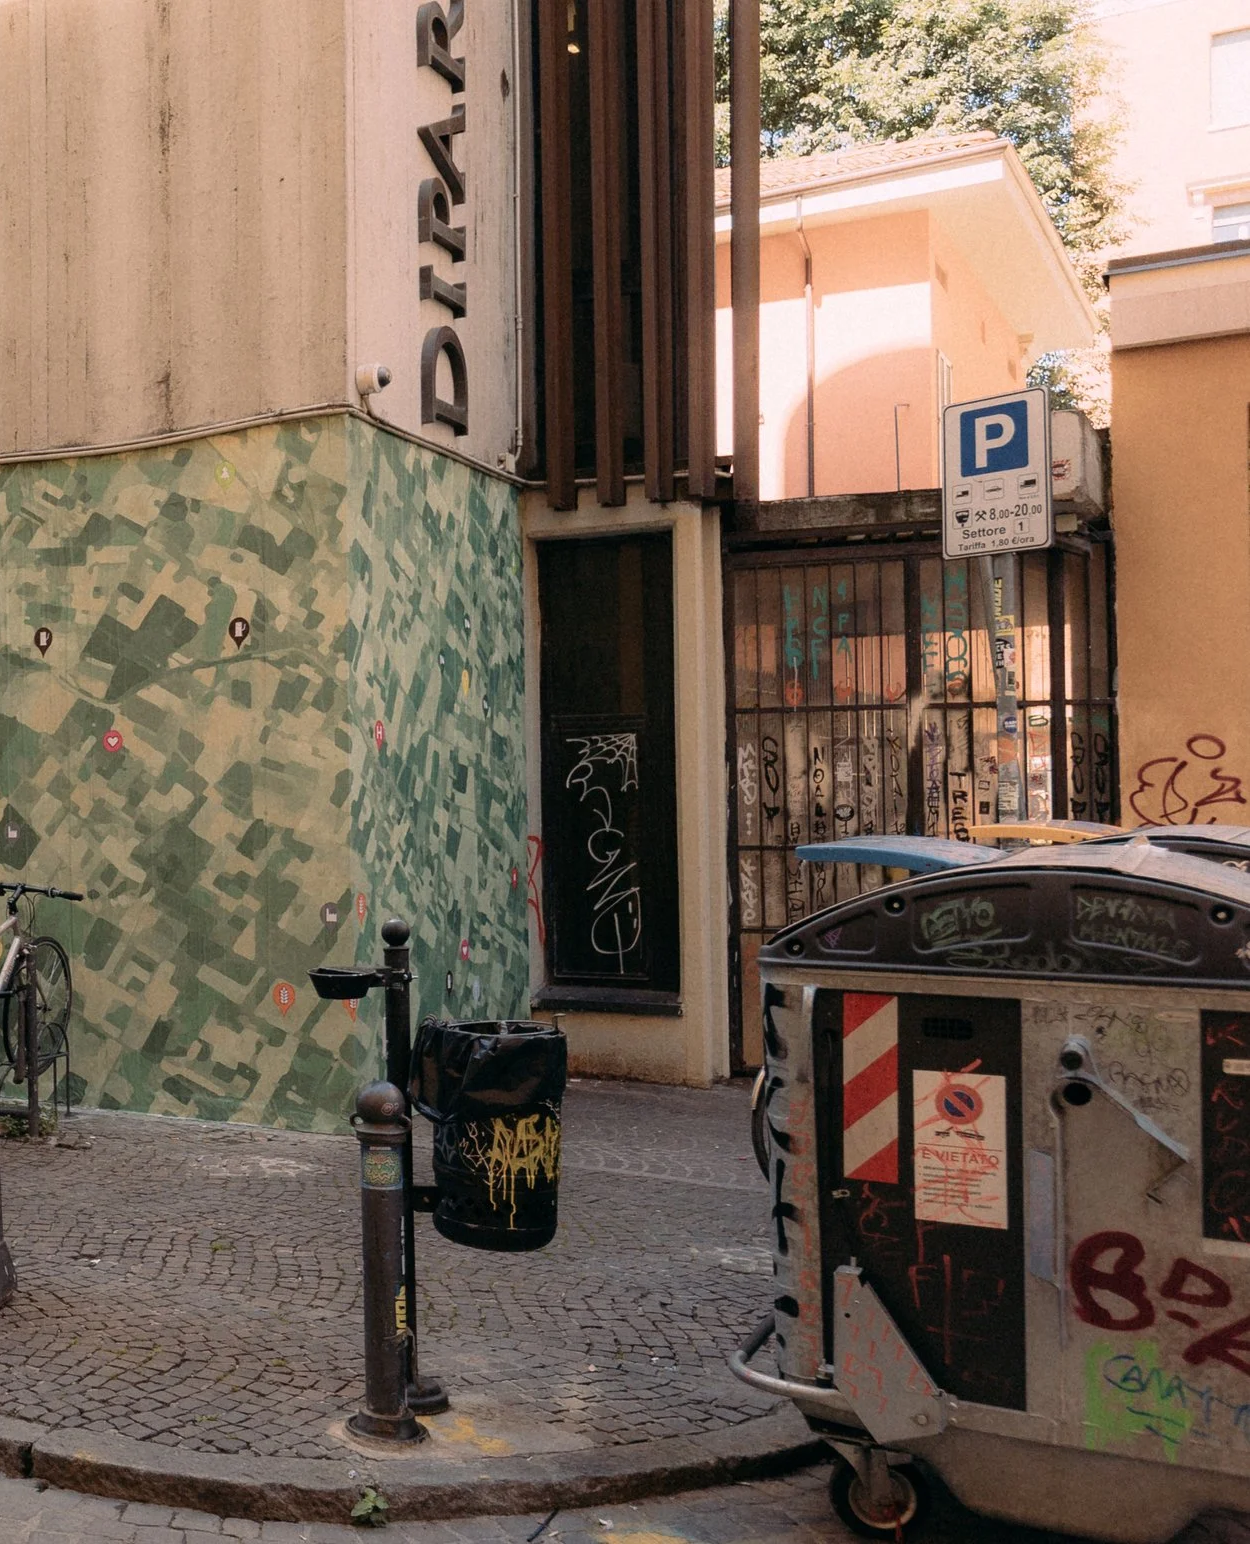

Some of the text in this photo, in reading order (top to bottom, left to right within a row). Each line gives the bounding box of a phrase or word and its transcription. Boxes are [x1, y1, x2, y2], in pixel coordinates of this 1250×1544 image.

[974, 413, 1016, 469] P
[962, 521, 1024, 540] Settore 1
[958, 534, 1035, 552] Tariffa 1,80 €/ora
[935, 1149, 1001, 1168] VIETATO
